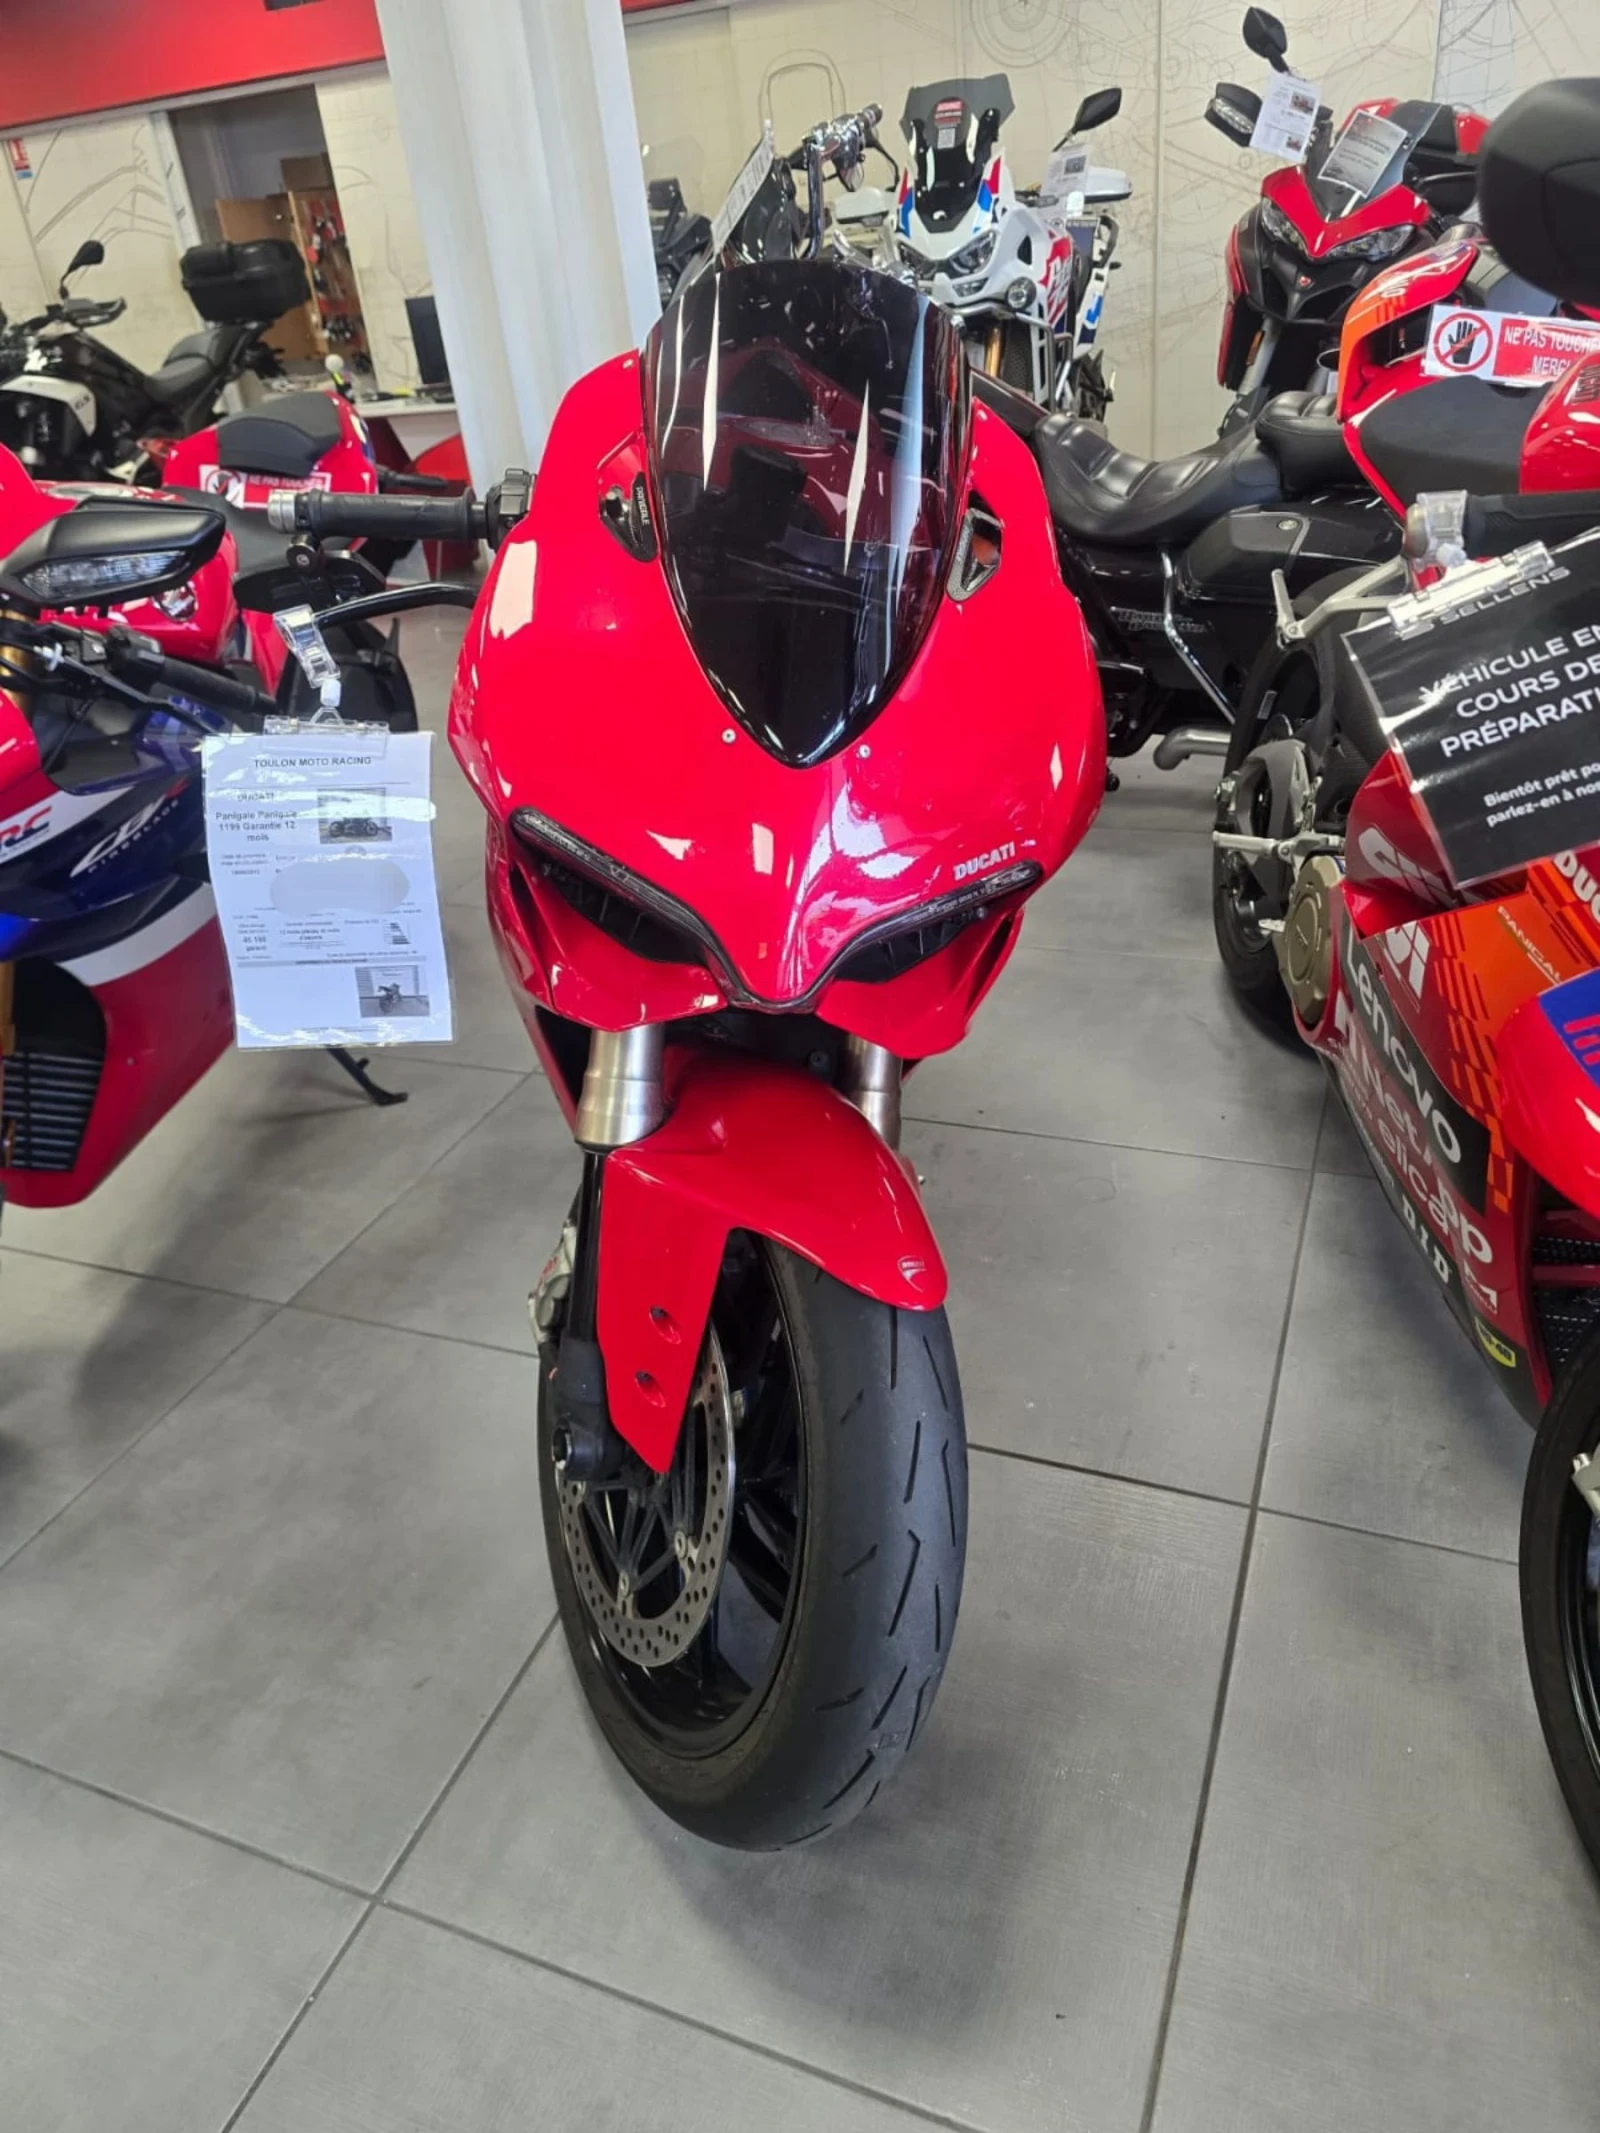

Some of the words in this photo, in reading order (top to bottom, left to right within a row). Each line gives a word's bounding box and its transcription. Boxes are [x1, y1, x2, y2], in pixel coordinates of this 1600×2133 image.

[1503, 325, 1521, 346] NE
[1522, 327, 1547, 349] PAS
[1440, 566, 1572, 625] SELLENS
[1456, 670, 1562, 718] COURS
[1564, 653, 1600, 682] DE
[255, 758, 297, 768] TOULON
[299, 757, 329, 767] MOTO
[331, 756, 372, 766] RACING
[1483, 779, 1543, 808] Bientôt
[1544, 768, 1579, 790] prêt
[1486, 794, 1561, 828] parlez-en
[1562, 788, 1575, 802] à
[215, 811, 256, 822] Panigale
[219, 823, 241, 831] 1199
[243, 822, 282, 831] Garantie
[285, 821, 296, 829] 12
[247, 833, 270, 842] mois
[953, 841, 1016, 881] DUCATI
[1346, 920, 1462, 1164] Lenovo
[1378, 1117, 1449, 1236] elica
